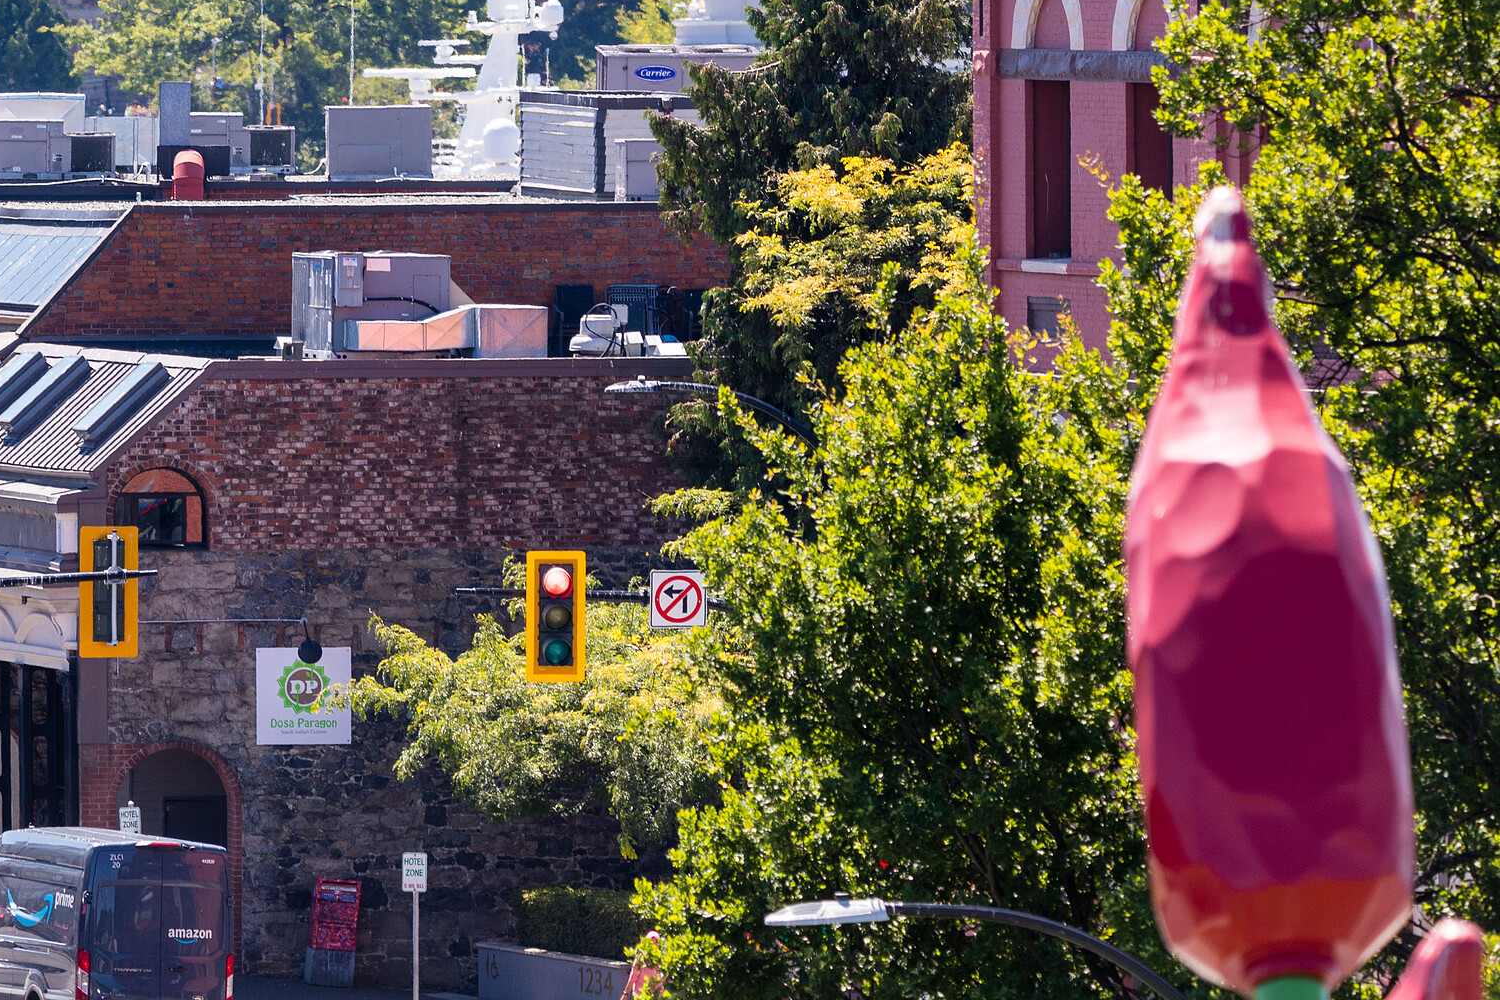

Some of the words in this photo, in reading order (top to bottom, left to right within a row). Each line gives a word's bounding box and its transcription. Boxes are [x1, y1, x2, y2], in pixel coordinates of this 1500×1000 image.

[640, 69, 671, 78] Carrier
[289, 680, 318, 695] DP
[270, 718, 295, 728] Dosa
[297, 718, 338, 729] Paragon
[122, 820, 139, 829] ZONE
[404, 858, 425, 866] HOTEL
[405, 869, 424, 877] ZONE
[54, 889, 75, 910] prime
[168, 928, 212, 940] amazon
[578, 966, 613, 996] 1234
